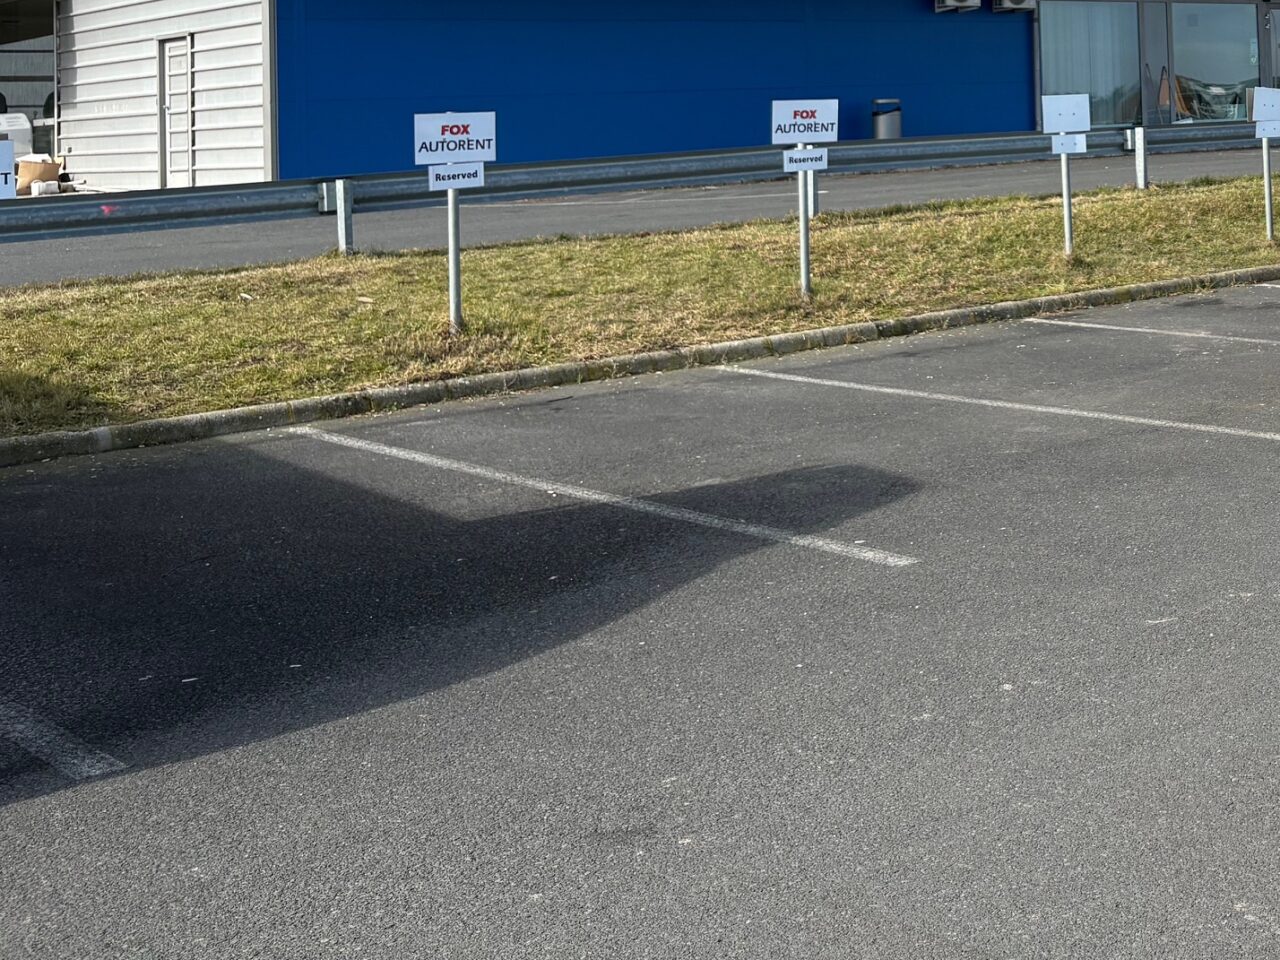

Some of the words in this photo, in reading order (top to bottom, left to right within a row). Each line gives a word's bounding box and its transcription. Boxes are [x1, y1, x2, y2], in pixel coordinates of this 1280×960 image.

[793, 109, 817, 120] FOX
[441, 124, 471, 136] FOX
[775, 122, 836, 134] AUTORENT
[418, 138, 493, 153] AUTORENT
[788, 154, 823, 164] Reserved
[435, 170, 478, 182] Reserved
